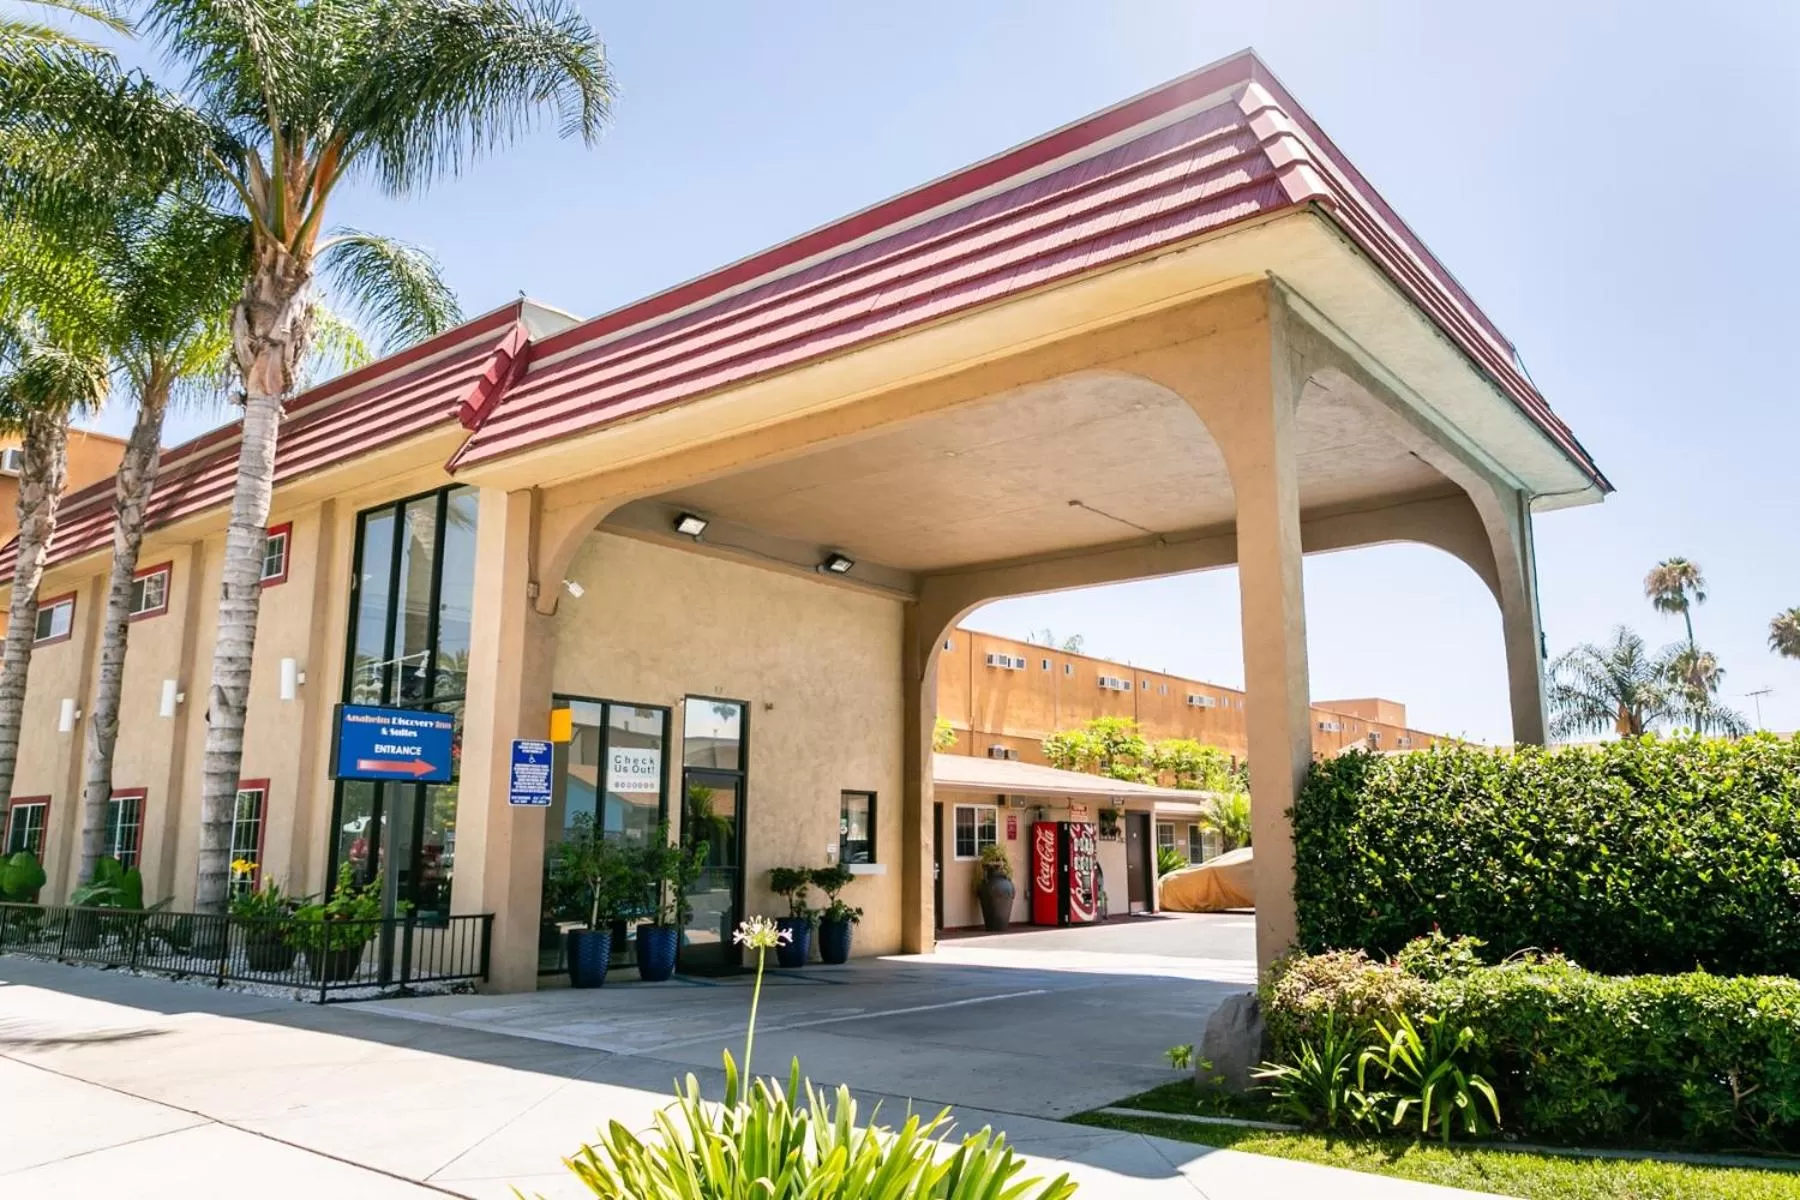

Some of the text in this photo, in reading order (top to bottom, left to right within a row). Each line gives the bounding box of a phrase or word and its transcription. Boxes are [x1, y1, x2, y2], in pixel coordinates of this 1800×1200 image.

[345, 714, 390, 724] Anaheim
[391, 716, 434, 728] Discovery
[380, 727, 418, 738] & Suites
[374, 744, 423, 756] ENTRANCE
[614, 754, 655, 765] Check
[614, 764, 655, 774] Us Out!
